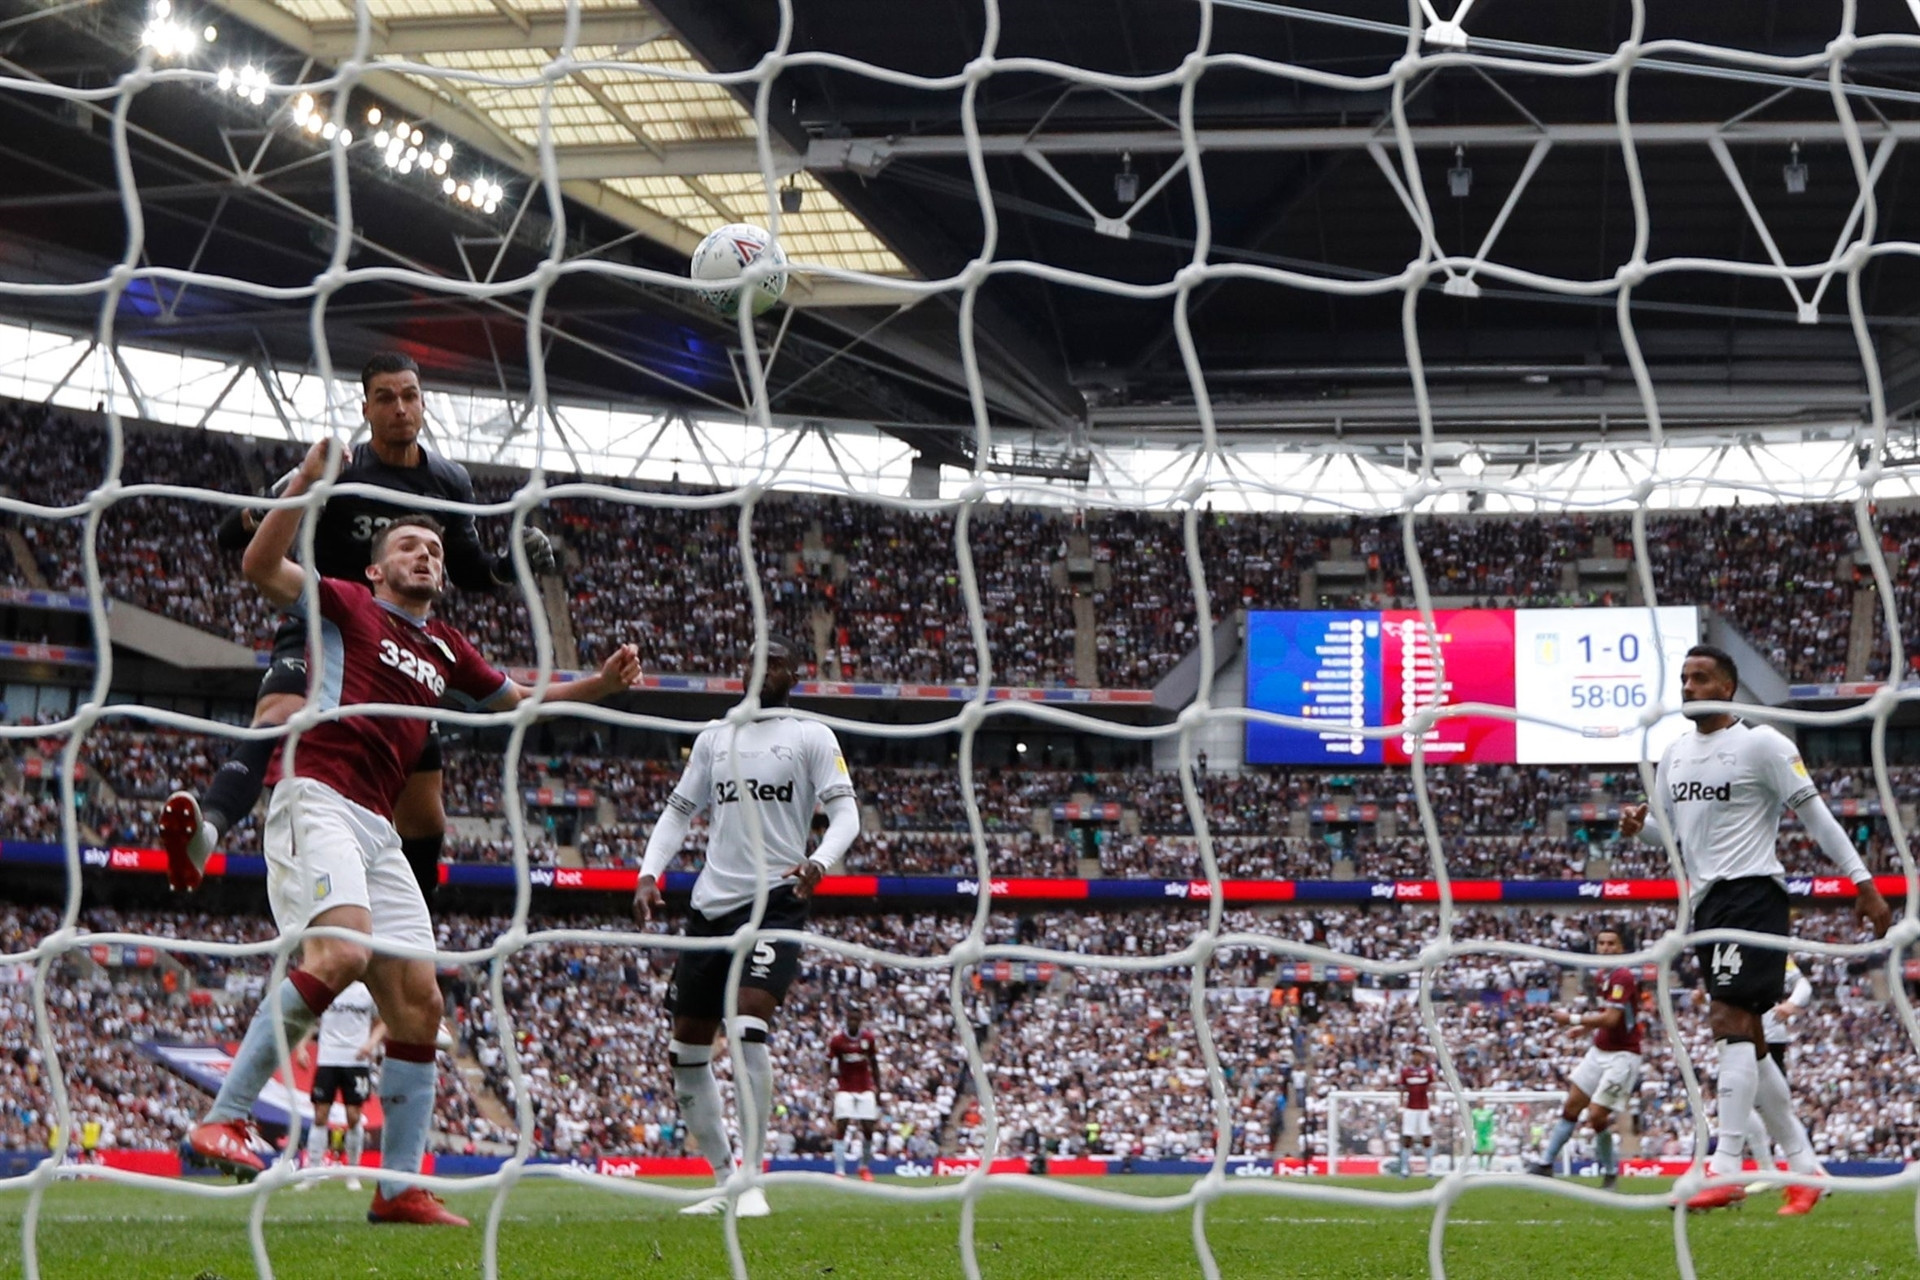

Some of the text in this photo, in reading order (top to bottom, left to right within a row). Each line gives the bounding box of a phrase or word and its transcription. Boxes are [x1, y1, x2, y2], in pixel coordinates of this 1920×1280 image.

[1571, 684, 1648, 708] 58:06
[715, 778, 794, 806] 32Red
[84, 847, 140, 867] sky bet
[530, 869, 583, 887] sky bet
[956, 879, 980, 896] sky
[1164, 881, 1189, 898] sky
[1371, 882, 1423, 899] sky bet
[1578, 881, 1631, 898] sky bet
[1786, 879, 1841, 896] sky bet
[752, 938, 776, 965] 5
[1711, 942, 1743, 975] 14
[601, 1159, 641, 1177] bet
[937, 1160, 979, 1177] bet
[1277, 1163, 1319, 1177] bet
[1622, 1163, 1664, 1177] bet
